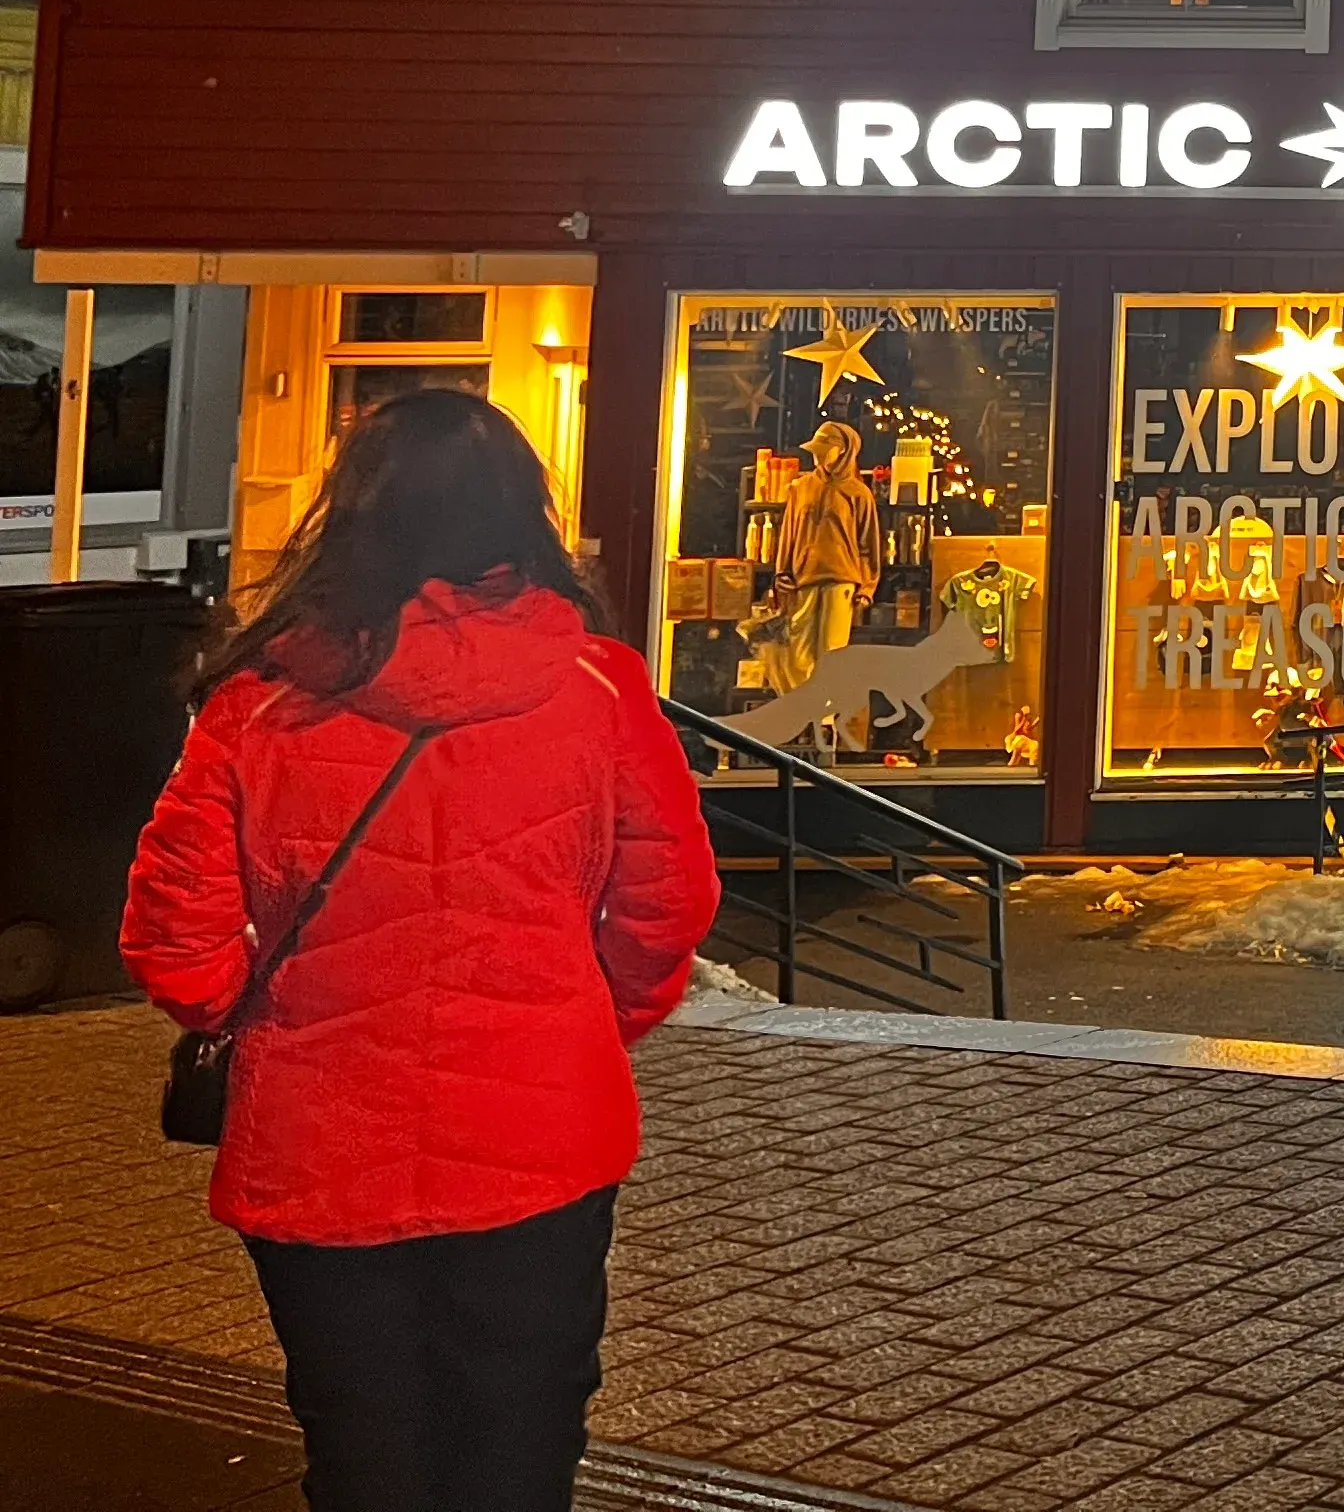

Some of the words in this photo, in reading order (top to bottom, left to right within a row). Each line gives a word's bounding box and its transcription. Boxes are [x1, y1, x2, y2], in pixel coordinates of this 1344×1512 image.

[722, 100, 1252, 189] ARCTIC
[778, 307, 910, 333] WILDRNES
[919, 307, 1033, 333] WSPERS.
